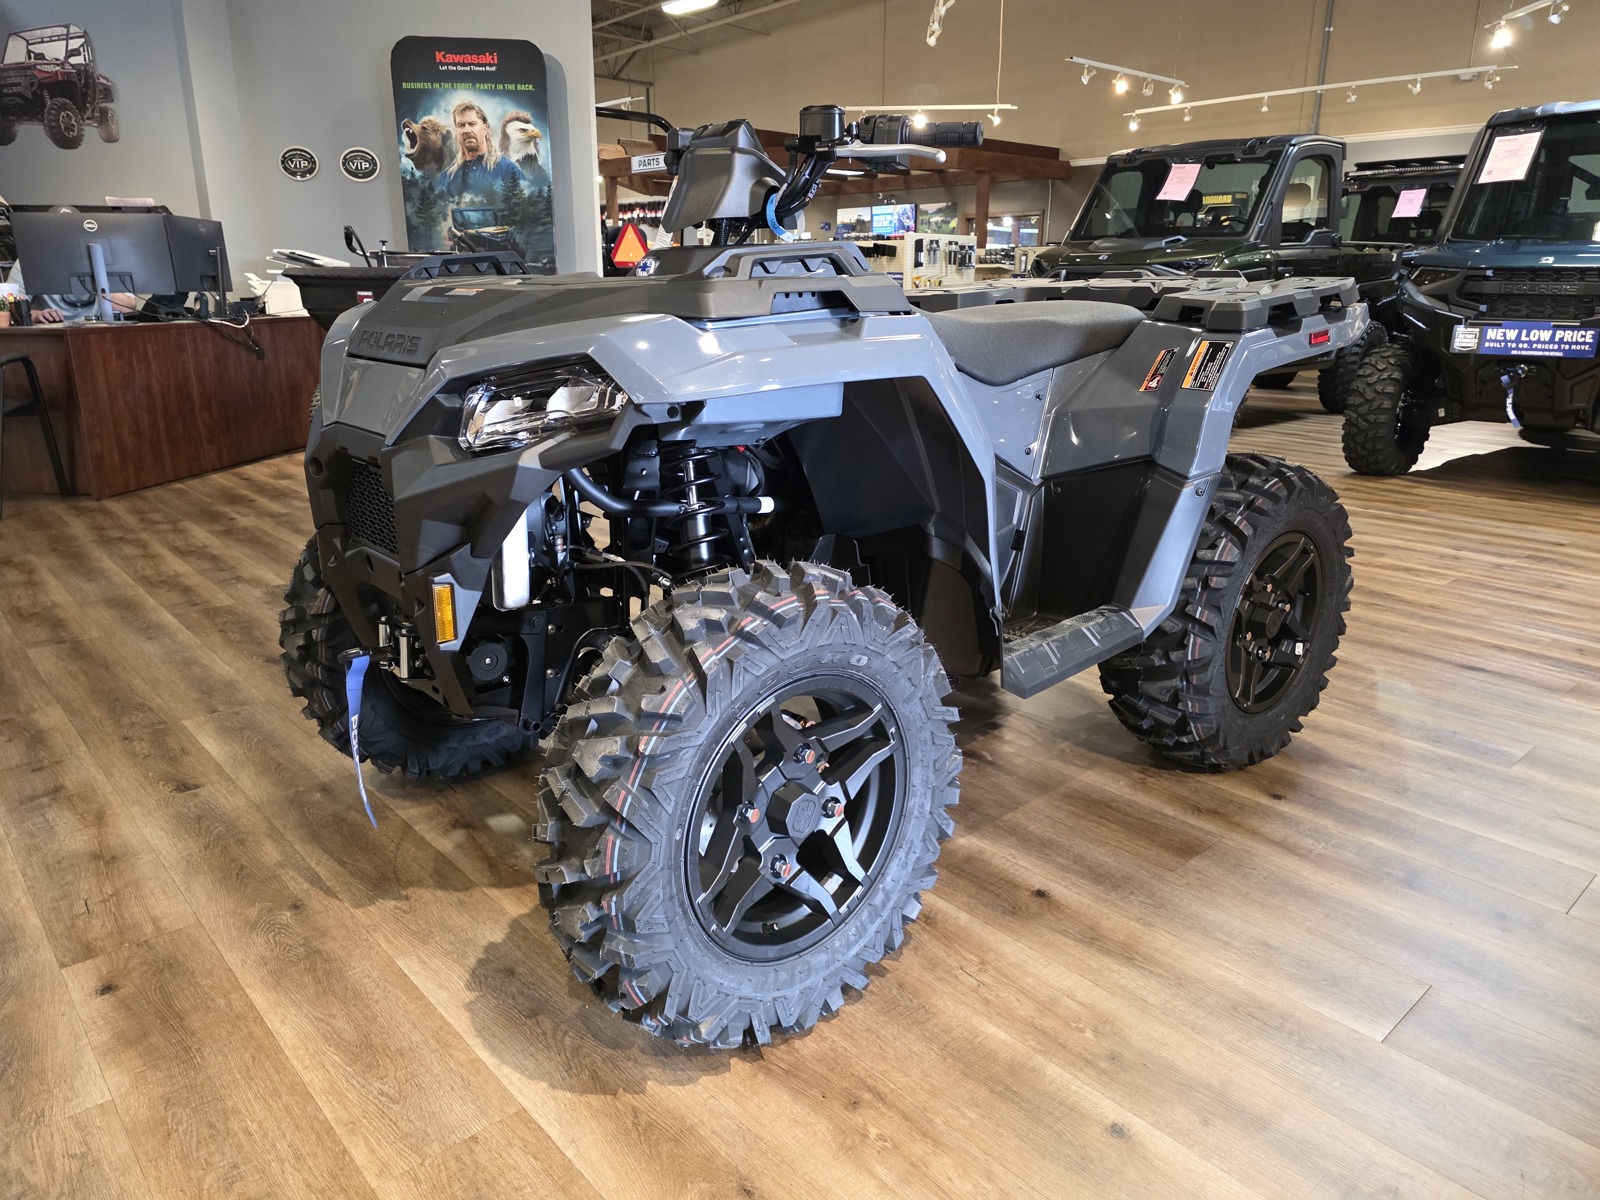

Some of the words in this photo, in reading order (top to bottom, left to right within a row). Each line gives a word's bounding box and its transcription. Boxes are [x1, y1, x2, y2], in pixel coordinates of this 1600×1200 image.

[435, 51, 498, 64] Kawasaki
[287, 160, 307, 168] VIP
[348, 161, 369, 169] VIP
[638, 157, 660, 168] PARTS
[1202, 194, 1233, 205] ANGUARD
[1486, 328, 1518, 341] NEW
[1520, 329, 1553, 342] LOW
[1554, 330, 1595, 343] PRICE
[358, 330, 422, 357] POLARIS
[757, 650, 869, 695] DURO
